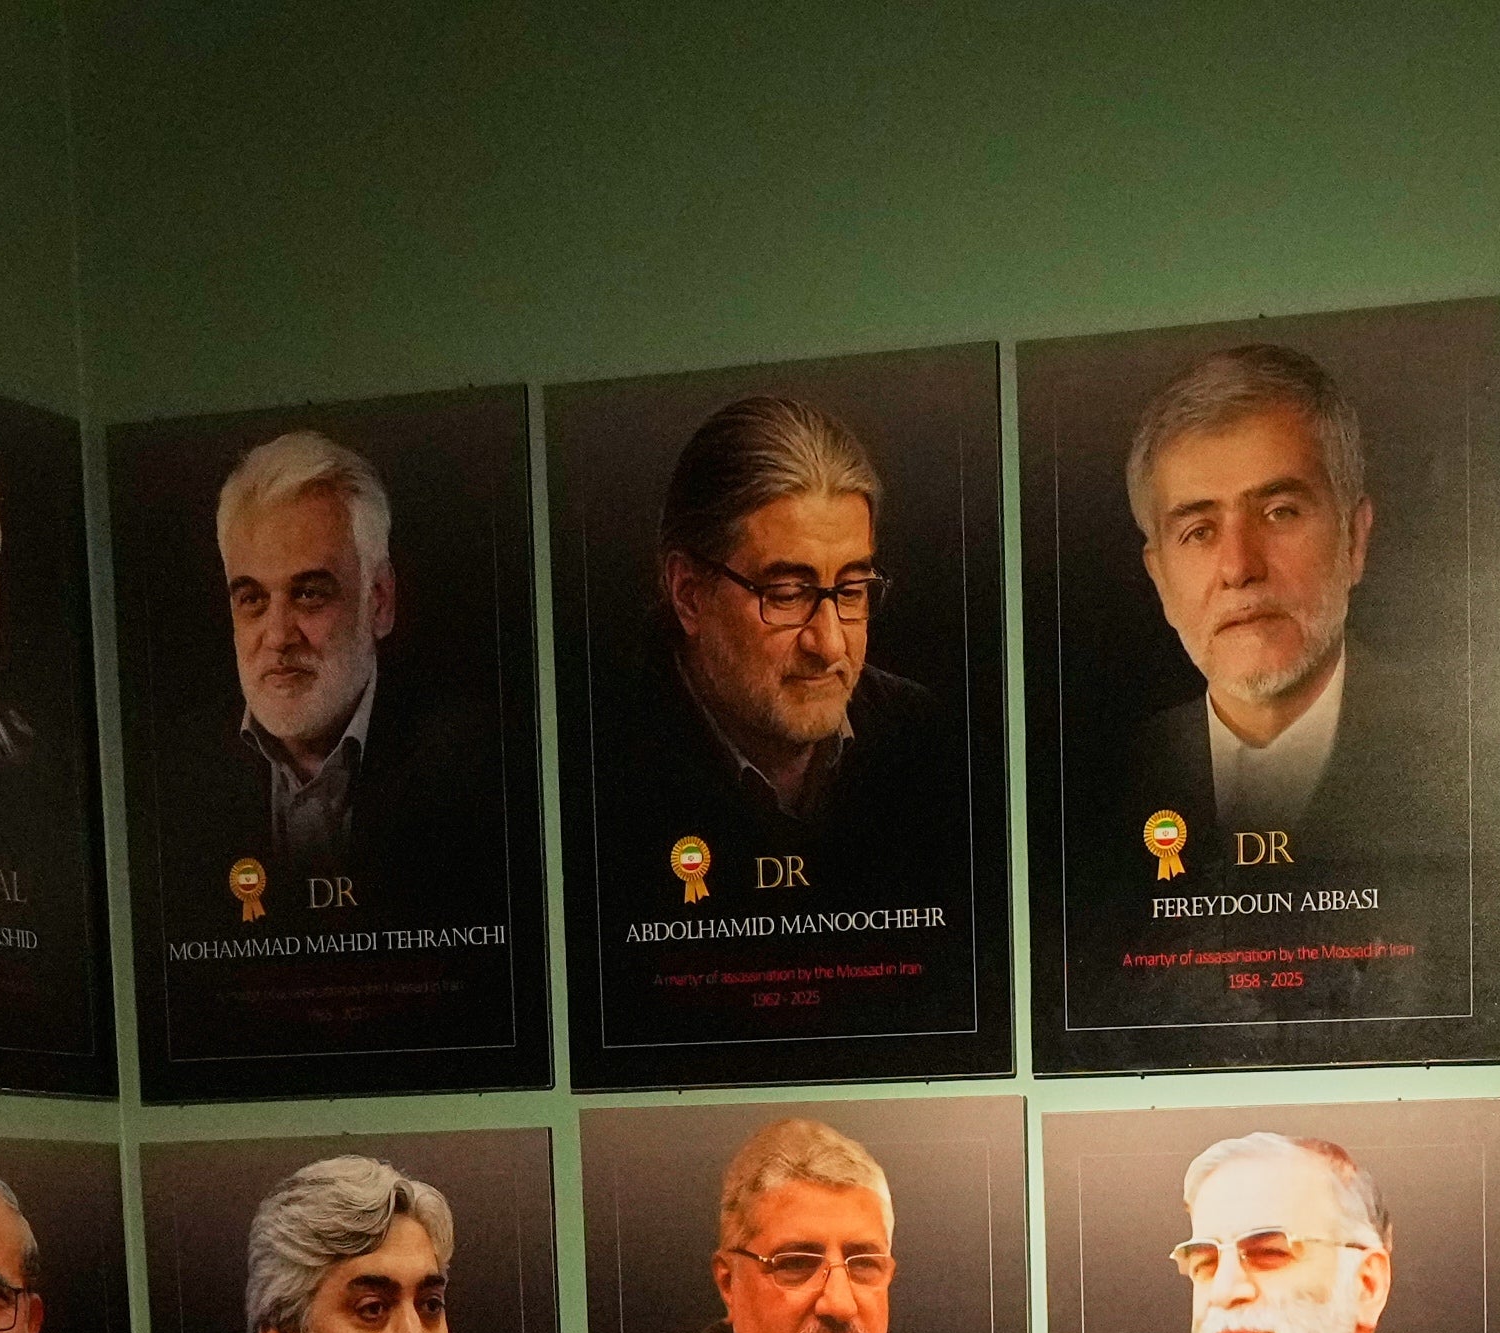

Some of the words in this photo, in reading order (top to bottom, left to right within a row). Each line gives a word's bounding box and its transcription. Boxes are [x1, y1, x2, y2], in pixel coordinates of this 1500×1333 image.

[1234, 831, 1294, 866] DR
[755, 855, 810, 889] DR
[308, 877, 358, 908] DR
[1152, 892, 1292, 918] FEREYDOUN
[1300, 889, 1378, 912] ABBASI
[626, 916, 774, 943] ABDOLHAMID
[780, 907, 946, 934] MANOOCHEHR
[170, 937, 300, 961] MOHAMMAD
[306, 932, 377, 954] MAHDI
[383, 925, 505, 949] TEHRANCHI
[1122, 953, 1132, 967] A
[1134, 954, 1176, 969] martyr
[1179, 950, 1193, 964] of
[1195, 948, 1275, 963] assassination
[1279, 946, 1294, 963] by
[1297, 945, 1318, 959] the
[1321, 942, 1371, 958] Mossad
[1374, 941, 1384, 955] in
[1389, 941, 1414, 954] Iran
[1228, 972, 1260, 989] 1958
[1270, 970, 1302, 987] 2025
